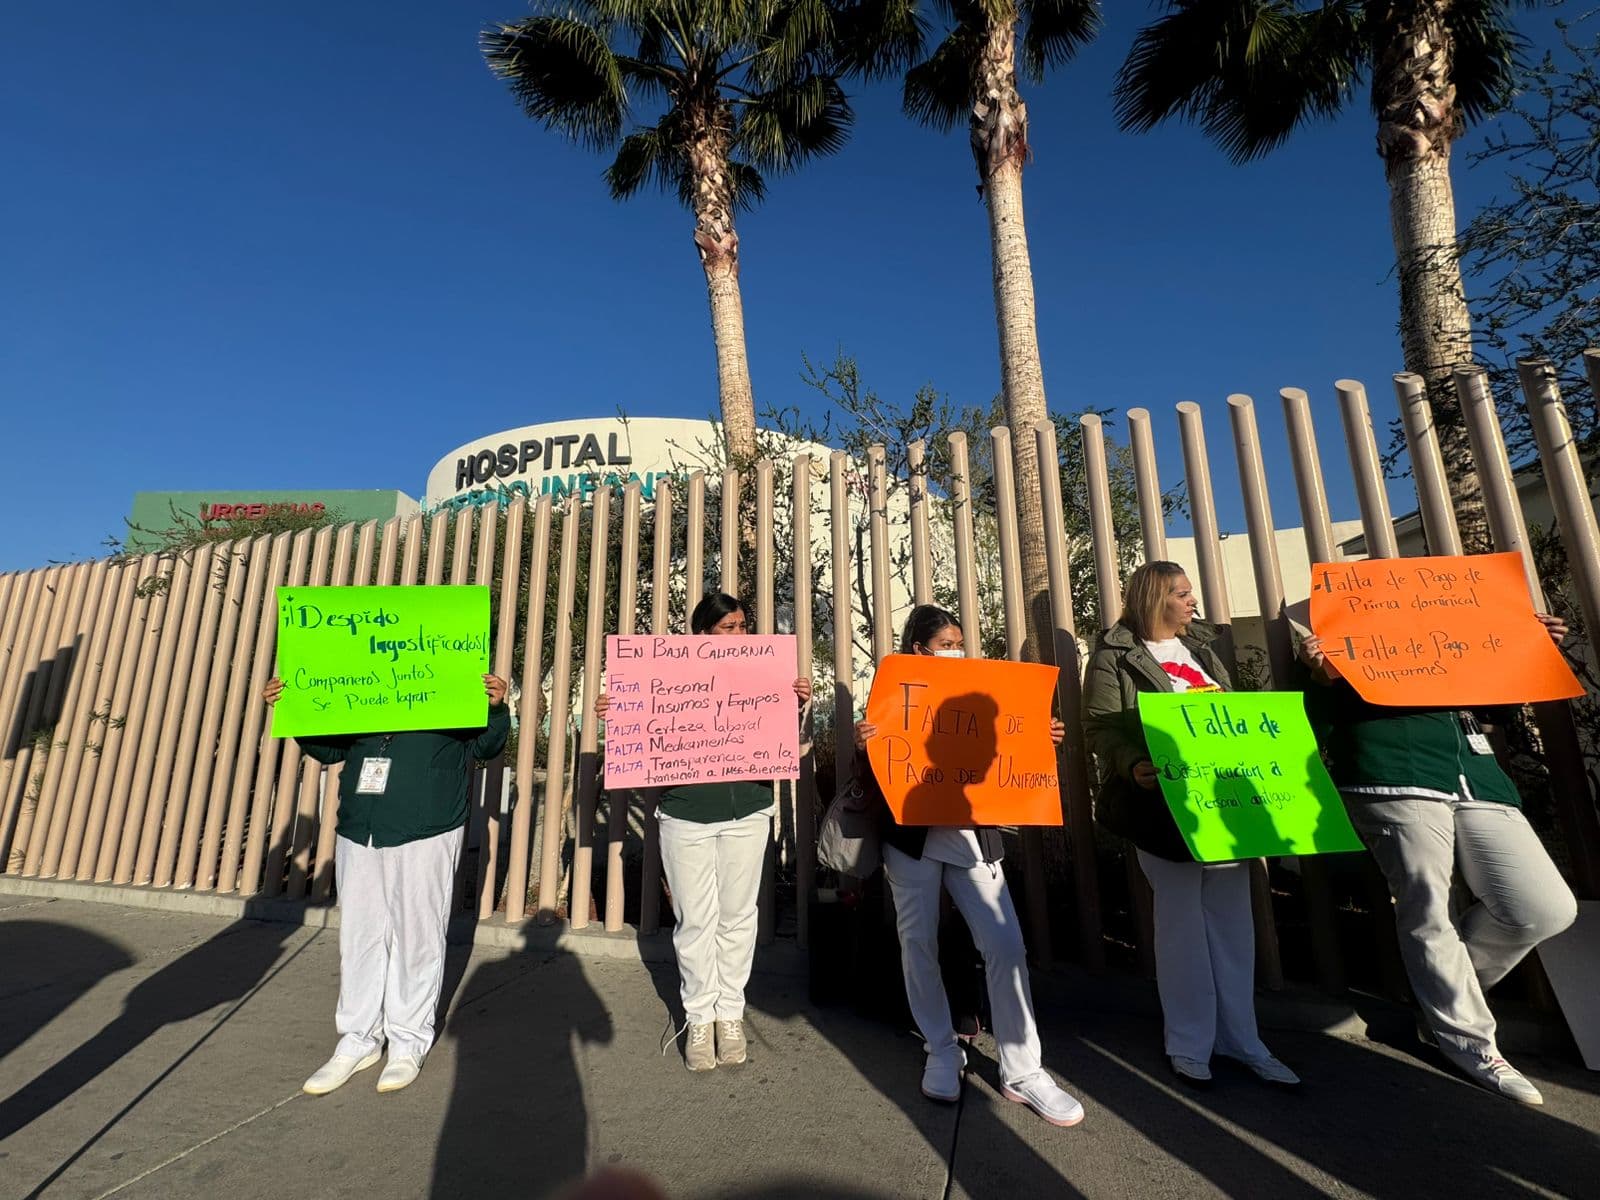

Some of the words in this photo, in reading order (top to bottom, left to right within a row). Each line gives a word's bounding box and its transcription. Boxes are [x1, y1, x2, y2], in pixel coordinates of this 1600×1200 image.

[456, 432, 632, 491] HOSPITAL
[1387, 569, 1408, 590] de
[1415, 568, 1457, 590] Pago
[1465, 567, 1484, 584] de
[1342, 596, 1400, 613] Prima
[1411, 588, 1480, 611] dominical
[1405, 637, 1423, 659] de
[1429, 630, 1469, 659] Pago
[1482, 633, 1503, 652] de
[386, 664, 434, 689] Juntos
[1362, 660, 1447, 683] Uniformes
[651, 676, 715, 695] Personal
[312, 697, 331, 711] Se
[344, 693, 389, 710] Puede
[396, 690, 436, 710] lograr
[652, 696, 709, 714] Insumos
[717, 700, 723, 717] y
[728, 693, 780, 712] Equipos
[899, 682, 979, 738] FALTA
[1005, 714, 1024, 735] DE
[647, 716, 706, 735] Certeza
[714, 716, 761, 732] laboral
[1170, 703, 1248, 738] Falta
[1259, 712, 1281, 739] de
[650, 733, 744, 752] Medicamentos
[650, 755, 746, 770] Transparencia
[753, 750, 769, 759] en
[779, 742, 795, 759] la
[882, 735, 944, 785] PAGO
[954, 768, 978, 785] DE
[998, 753, 1058, 789] UNIFORMES
[707, 769, 717, 777] a
[1270, 761, 1283, 776] a
[1188, 787, 1243, 812] Personal
